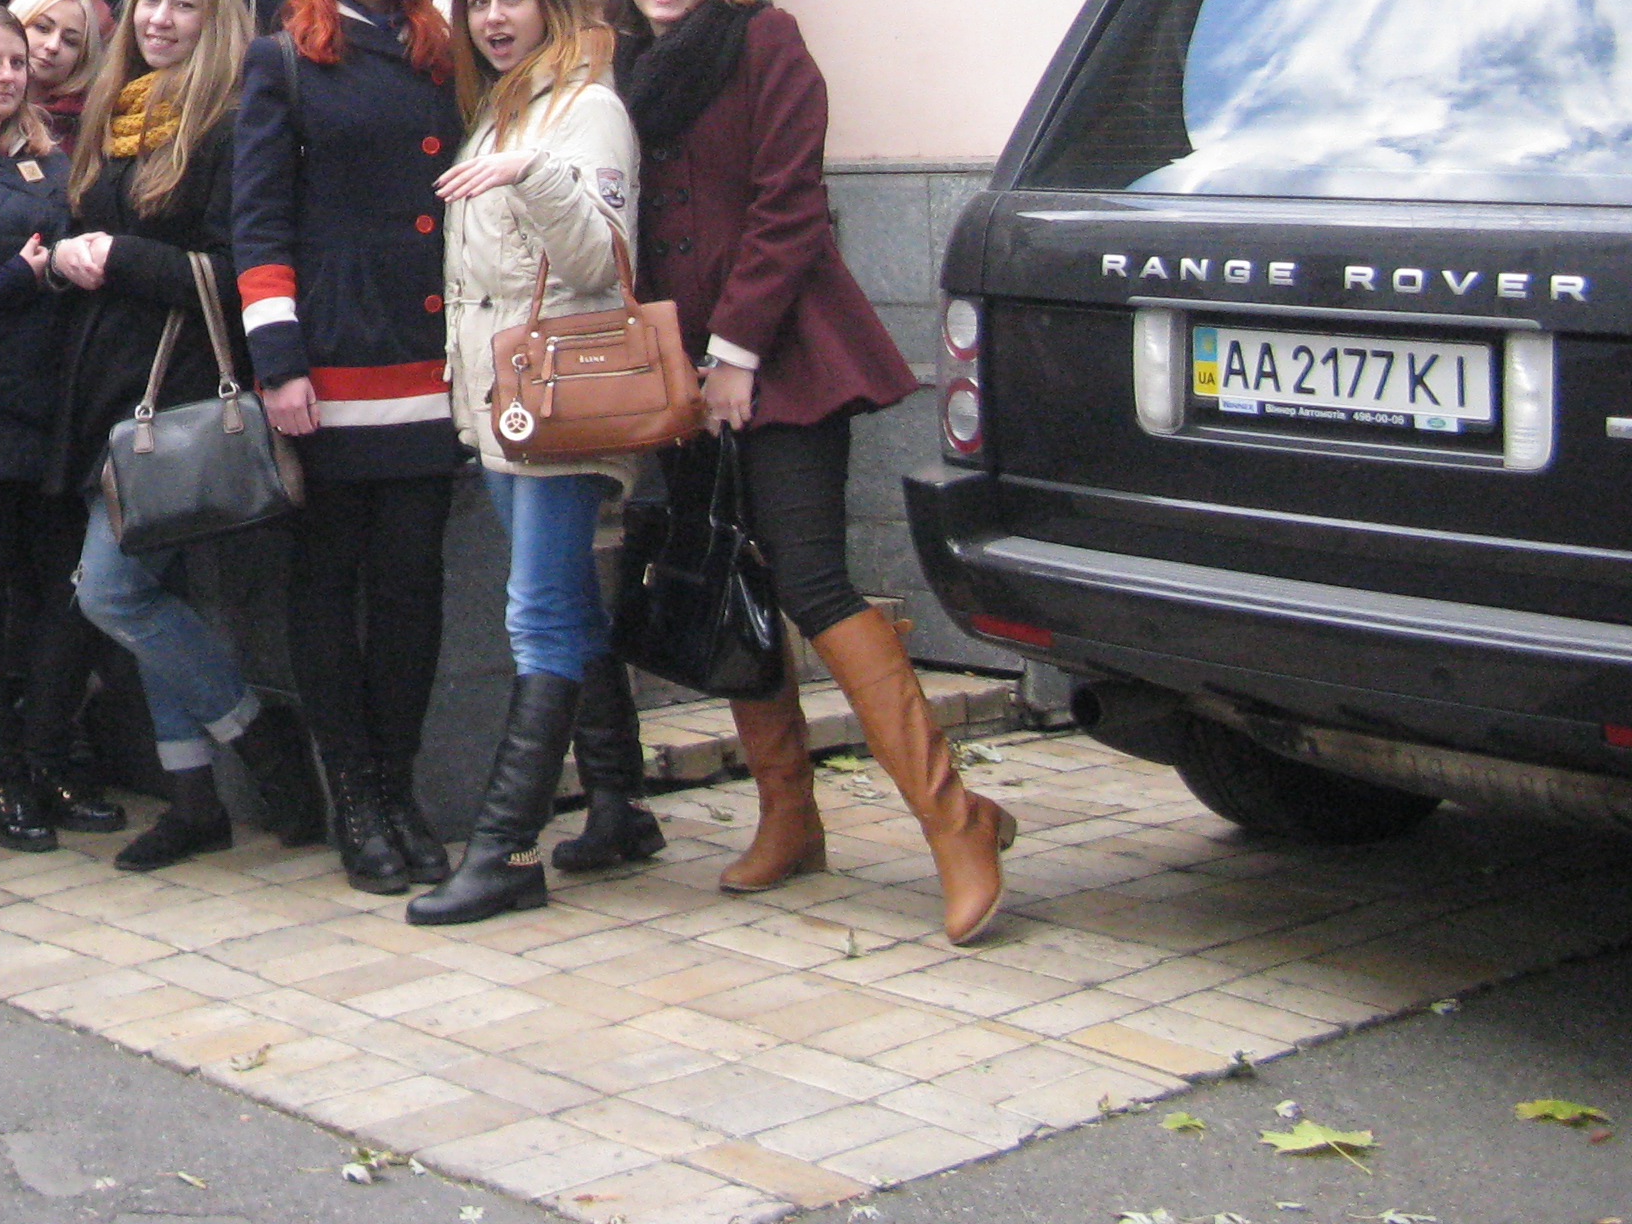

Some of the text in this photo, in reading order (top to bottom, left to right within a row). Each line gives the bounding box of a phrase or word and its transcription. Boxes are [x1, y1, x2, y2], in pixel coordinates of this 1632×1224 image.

[1101, 254, 1589, 302] RANGE ROVER
[1197, 370, 1216, 386] UA
